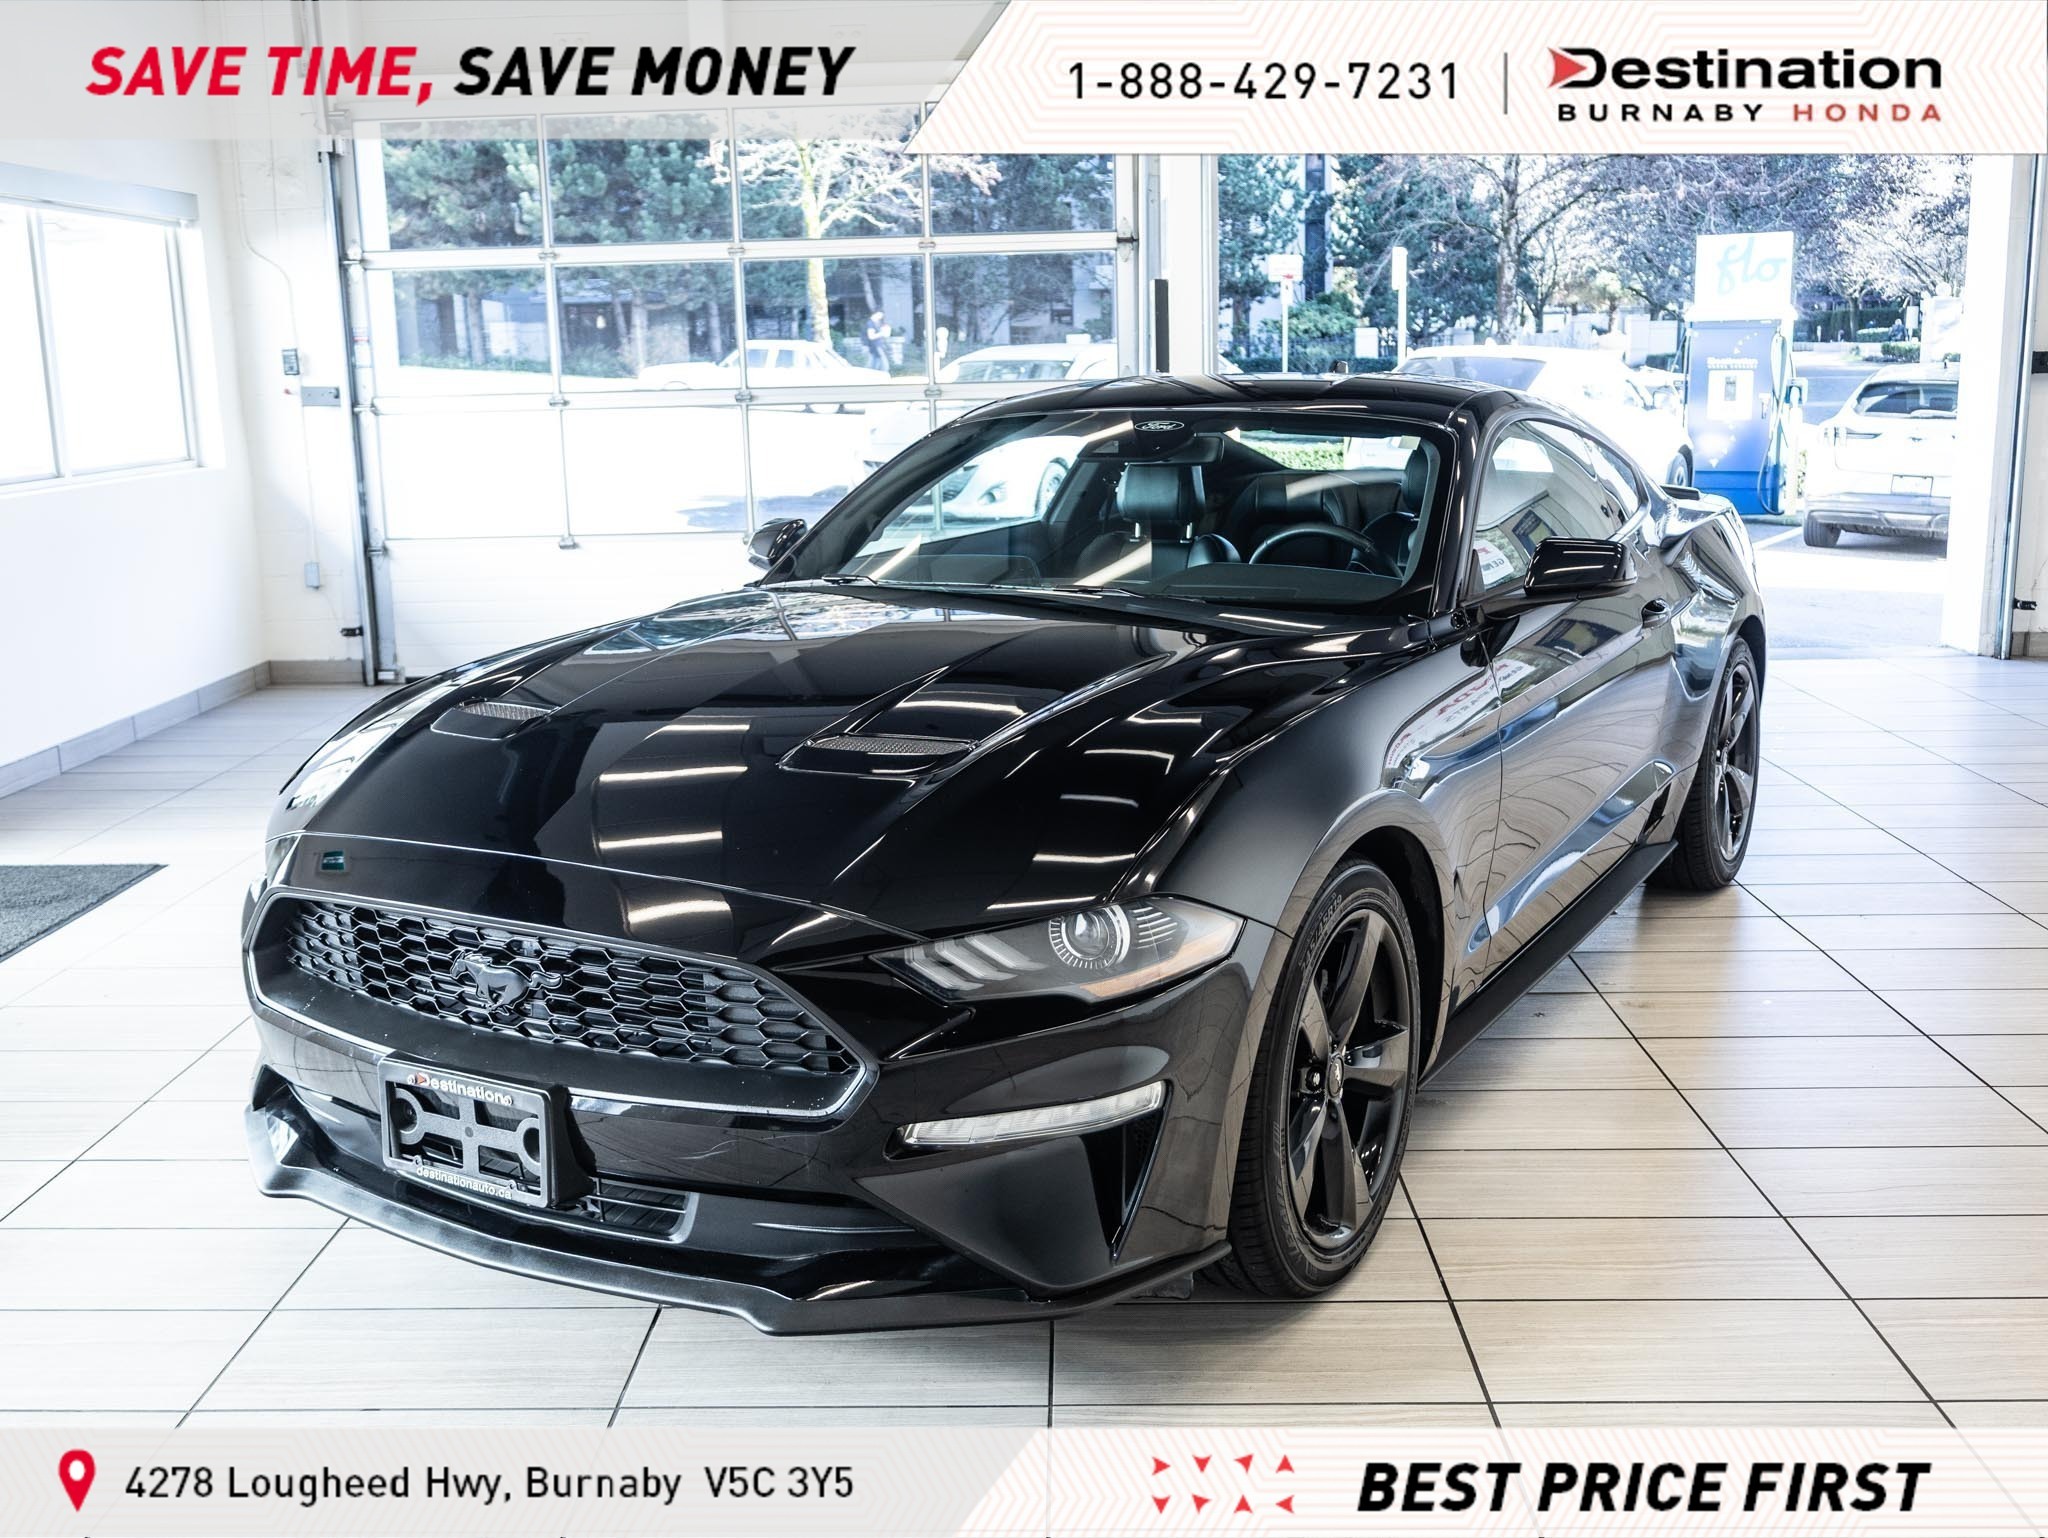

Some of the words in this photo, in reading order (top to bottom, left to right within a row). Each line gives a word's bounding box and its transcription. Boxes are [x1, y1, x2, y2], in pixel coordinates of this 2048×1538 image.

[1717, 236, 1787, 295] flo
[416, 1072, 506, 1103] Destination
[416, 1166, 512, 1199] destinationauto.ca
